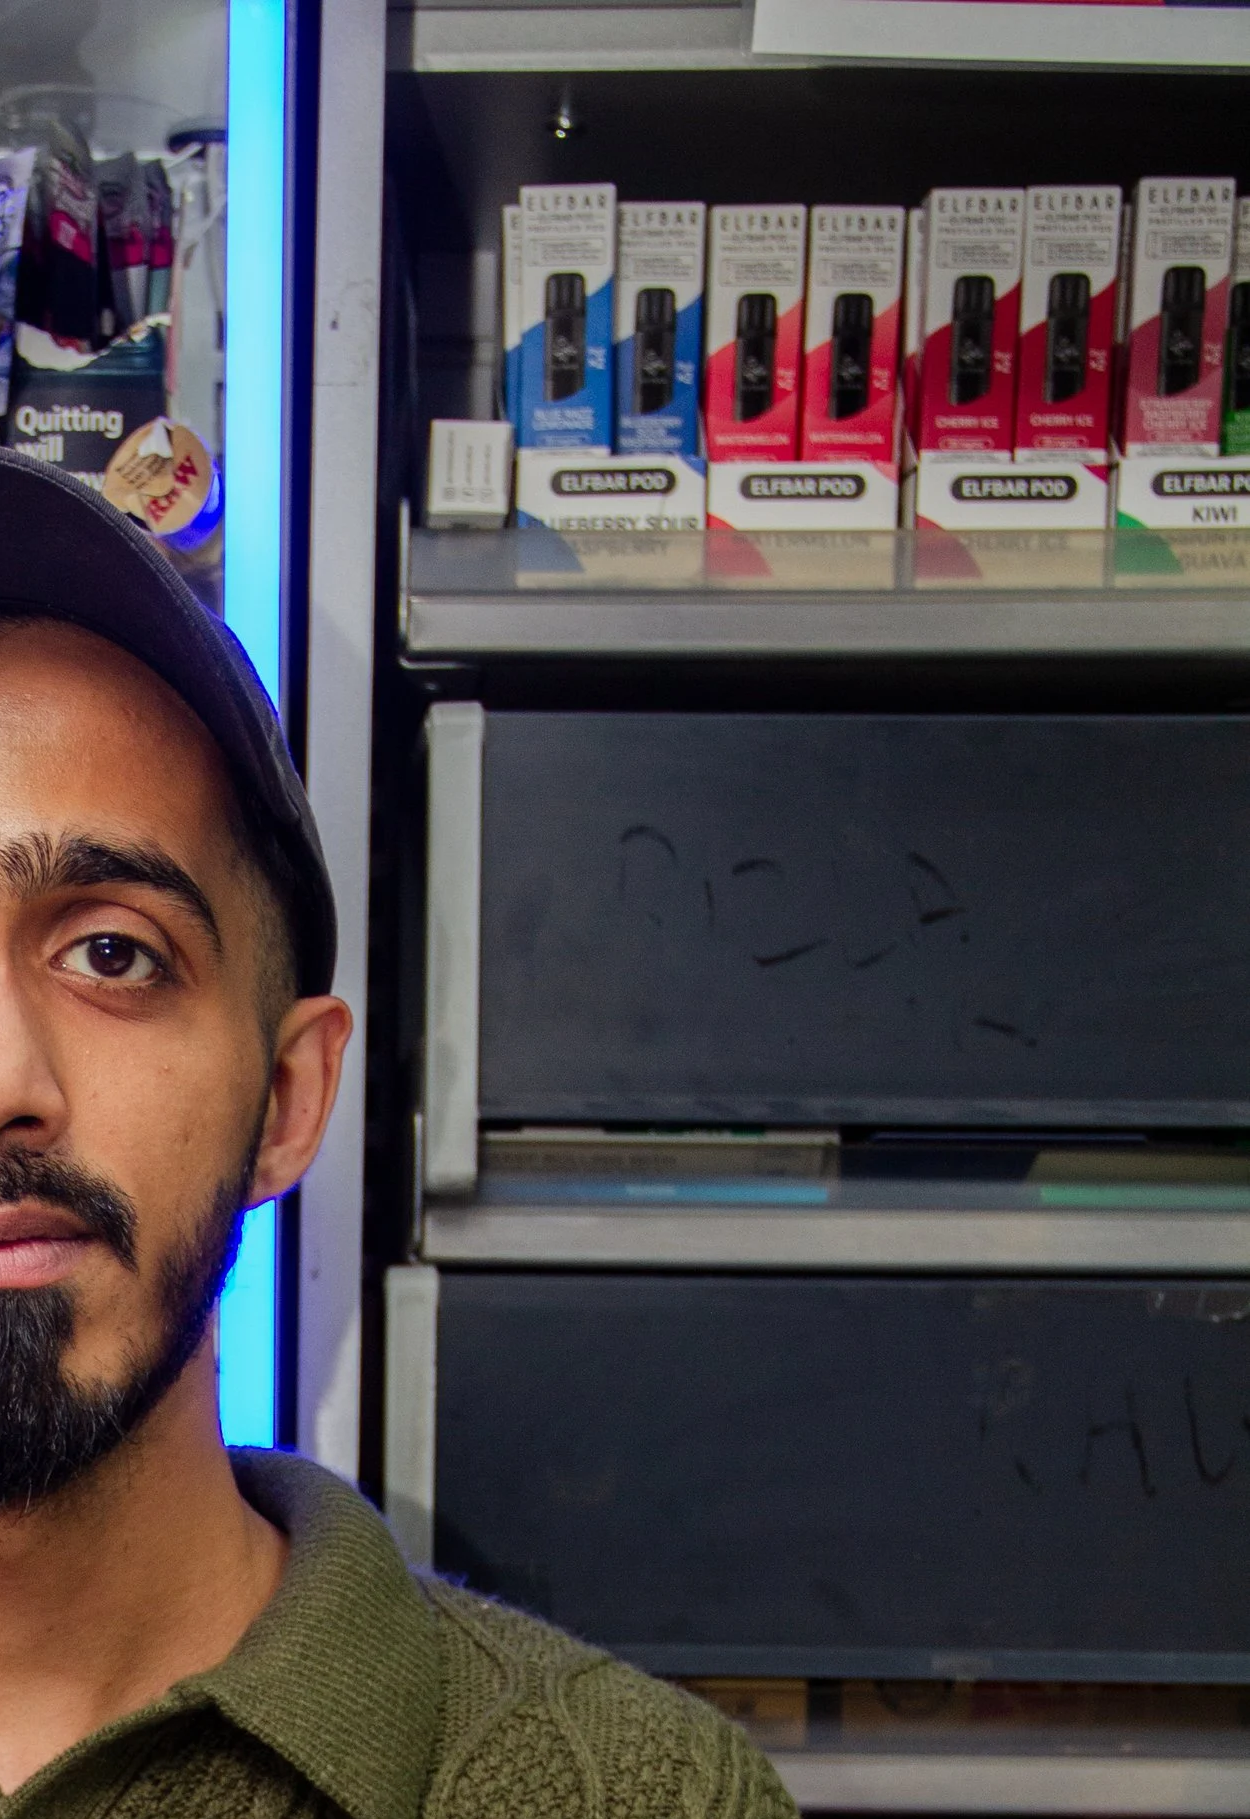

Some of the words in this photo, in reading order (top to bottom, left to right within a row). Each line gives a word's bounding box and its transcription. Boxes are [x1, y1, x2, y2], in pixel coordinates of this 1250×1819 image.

[16, 404, 124, 439] Quitting
[561, 473, 628, 492] ELFBAR
[629, 472, 668, 491] POD
[751, 477, 818, 496] ELFBAR
[819, 477, 858, 496] POD
[961, 480, 1029, 498] ELFBAR
[1030, 480, 1069, 498] POD
[1163, 476, 1231, 493] ELFBAR
[1192, 505, 1238, 522] KIWI
